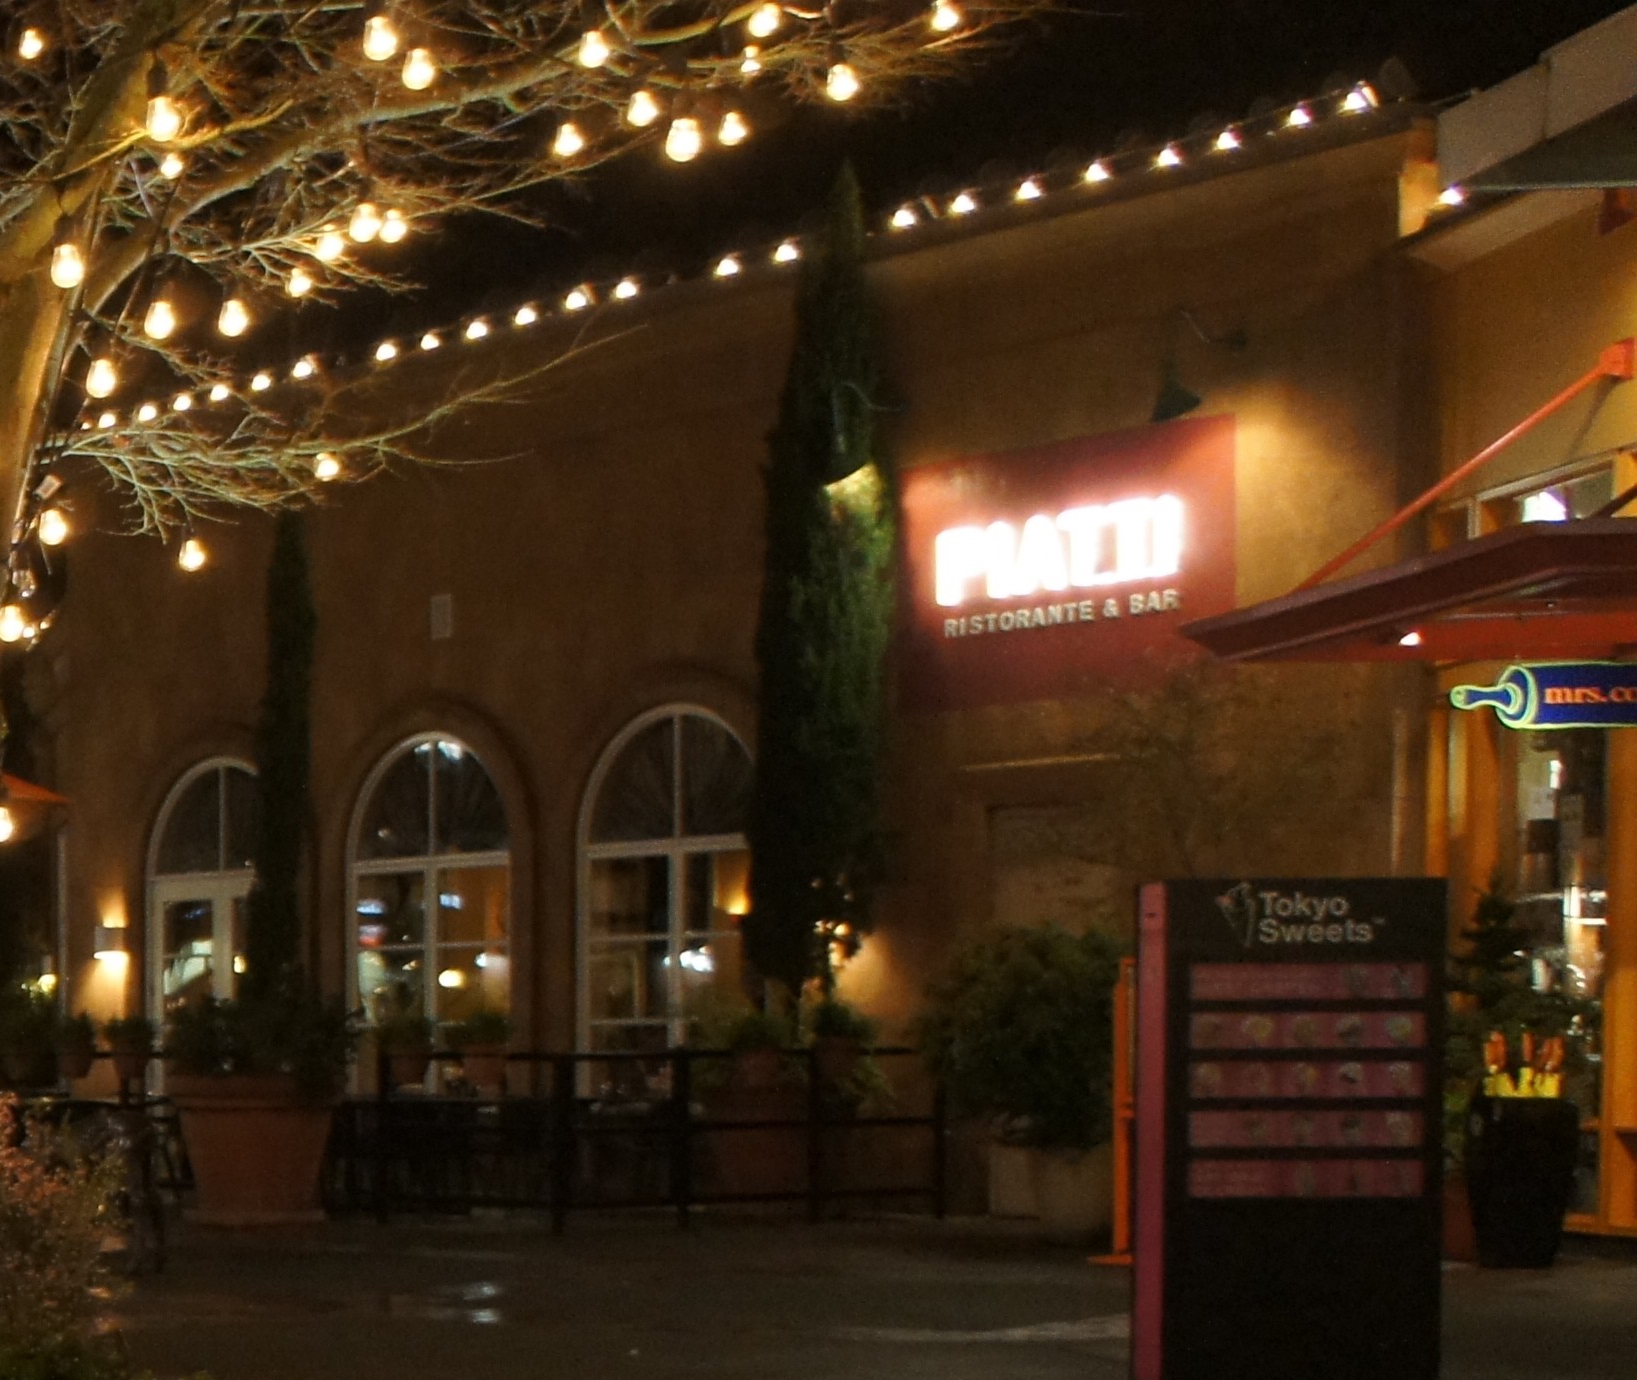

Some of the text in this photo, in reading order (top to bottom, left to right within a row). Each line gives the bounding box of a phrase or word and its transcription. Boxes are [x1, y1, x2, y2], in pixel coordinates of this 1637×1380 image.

[944, 588, 1180, 638] RISTORANTE & BAR
[1258, 890, 1350, 922] Tokyo
[1259, 917, 1375, 943] Sweets
